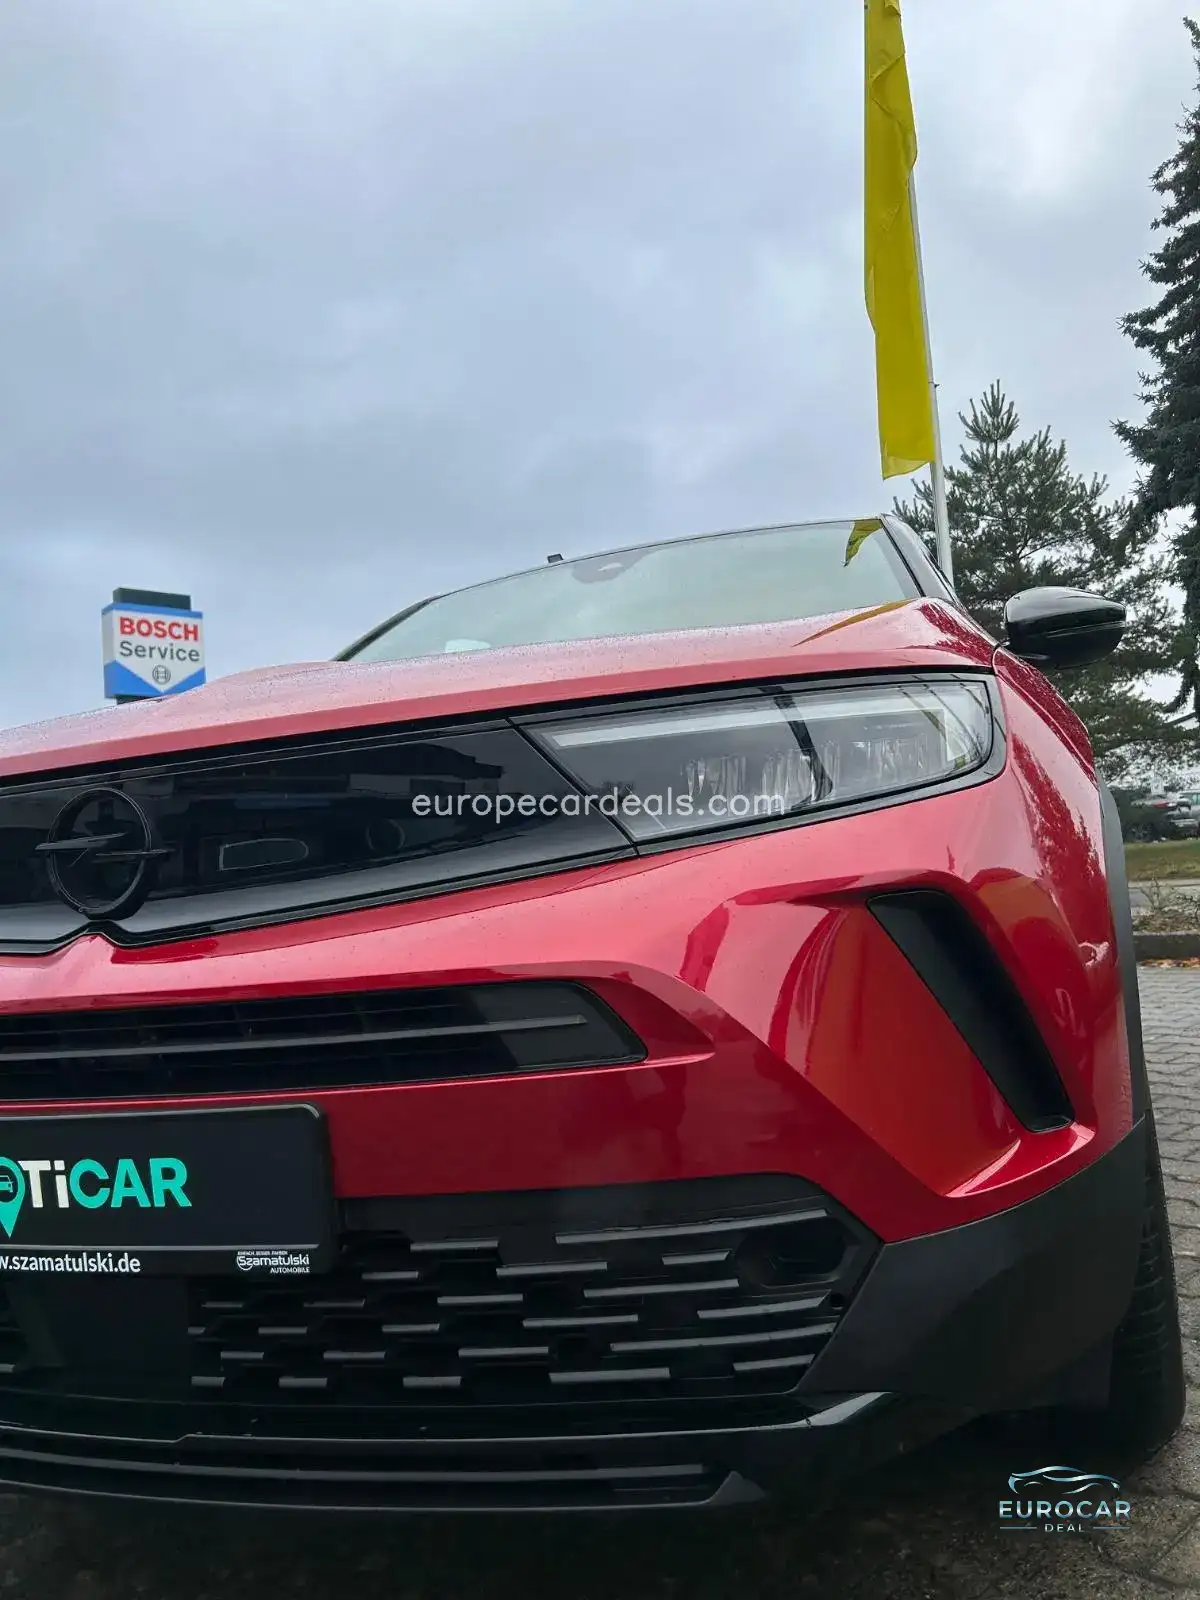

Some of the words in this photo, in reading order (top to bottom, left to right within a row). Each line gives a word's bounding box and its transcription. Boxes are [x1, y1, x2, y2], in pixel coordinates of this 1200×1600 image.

[119, 616, 199, 641] BOSCH
[119, 640, 200, 662] Service
[237, 1254, 310, 1268] Szamatulski
